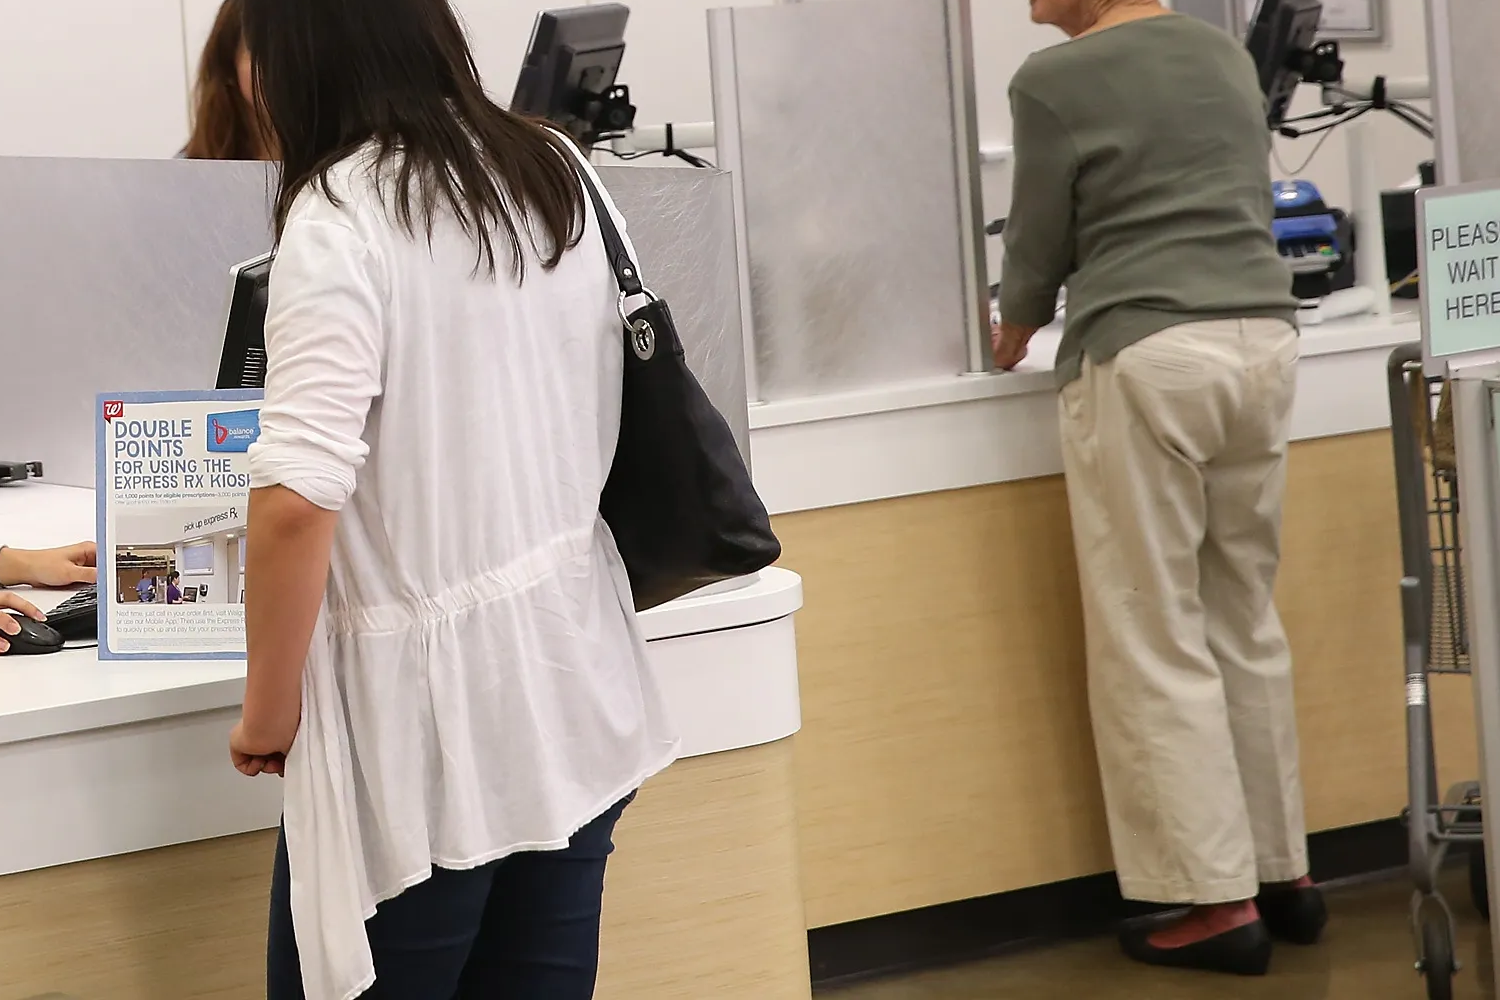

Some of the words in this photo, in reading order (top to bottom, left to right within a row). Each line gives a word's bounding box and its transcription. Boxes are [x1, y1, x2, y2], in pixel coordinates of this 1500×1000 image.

[1431, 220, 1500, 252] PLEAS
[1447, 255, 1499, 285] WAIT
[1446, 291, 1500, 321] HERE
[115, 419, 192, 439] DOUBLE
[115, 439, 184, 458] POINTS
[114, 460, 143, 475] FOR
[149, 459, 197, 474] USING
[203, 458, 232, 473] THE
[114, 475, 179, 490] EXPRESS
[184, 474, 204, 489] RX
[184, 523, 195, 533] pick
[196, 520, 204, 529] up
[203, 511, 229, 527] express
